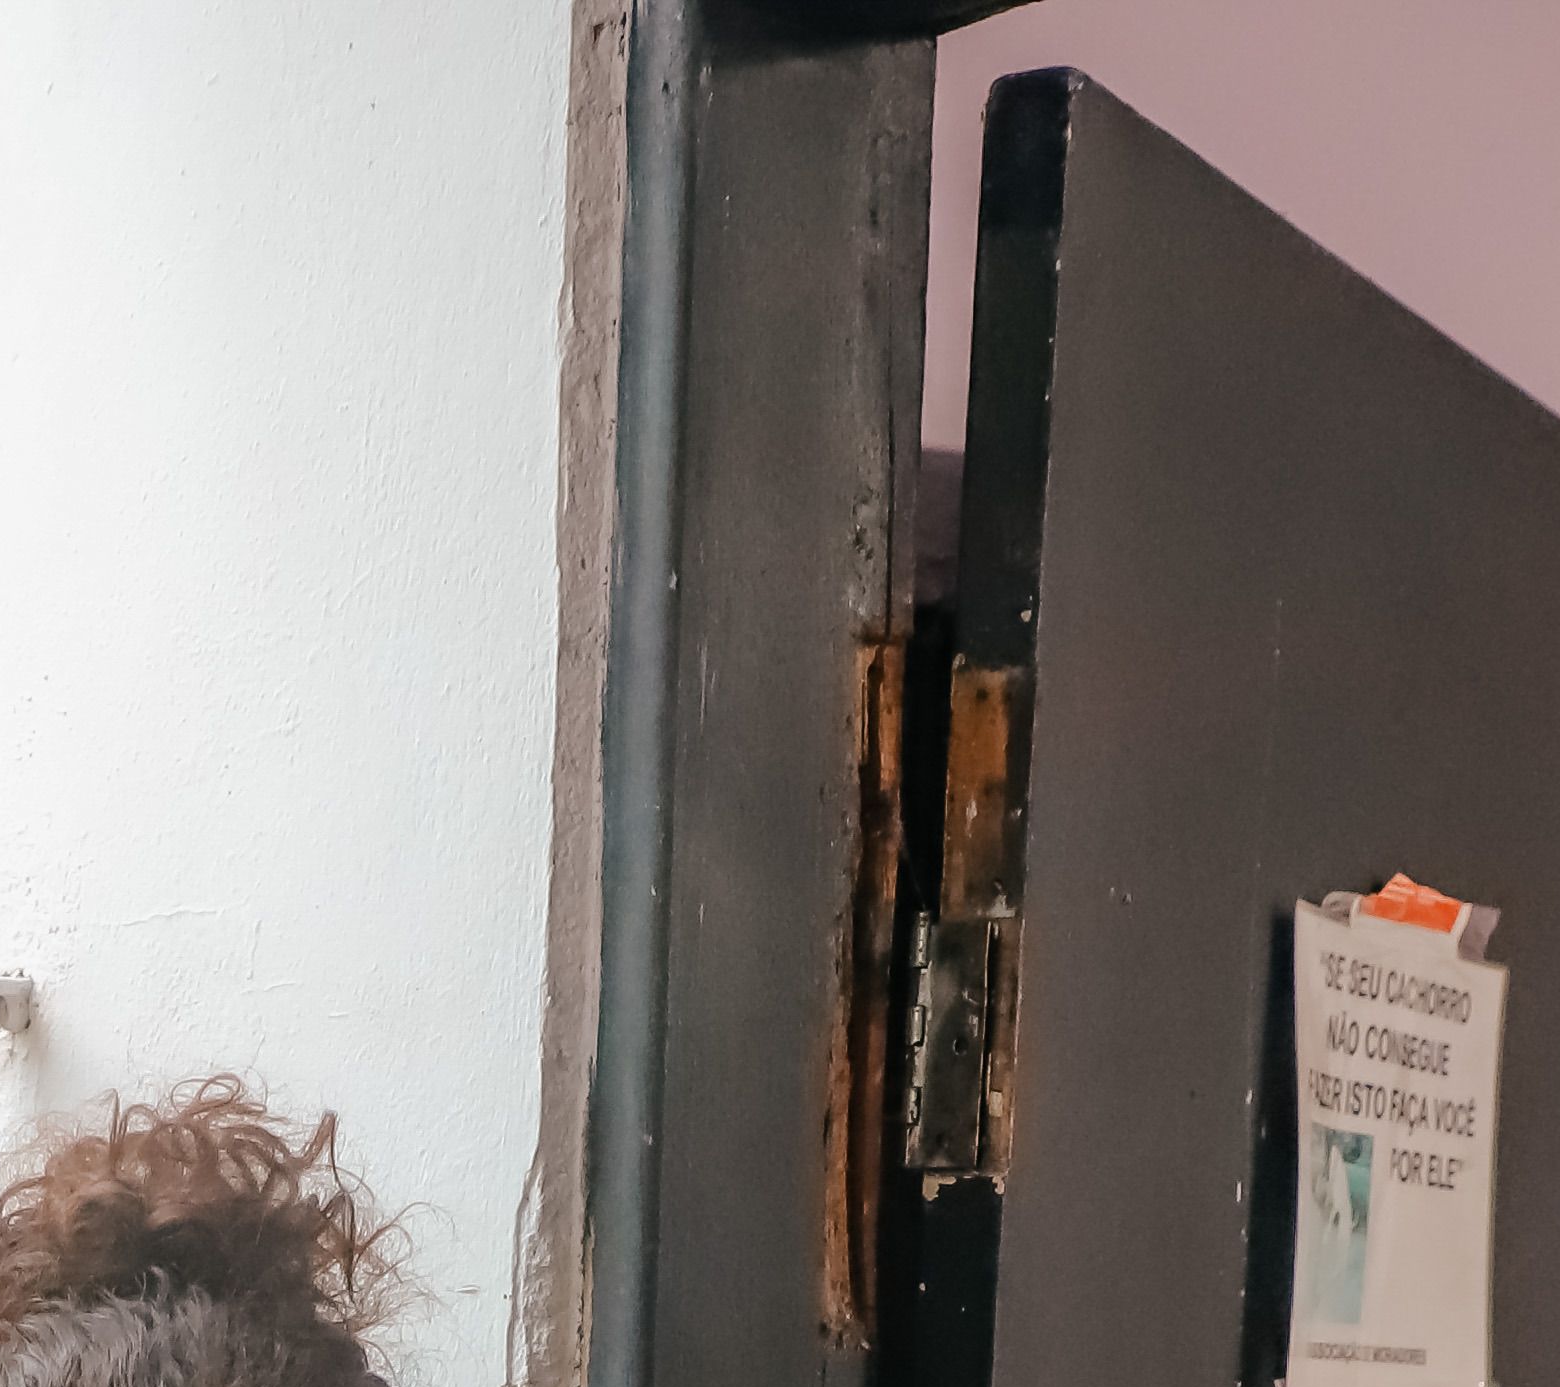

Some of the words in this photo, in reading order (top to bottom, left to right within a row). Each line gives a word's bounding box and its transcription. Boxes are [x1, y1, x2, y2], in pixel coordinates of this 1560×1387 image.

[1349, 959, 1382, 1000] SEU
[1386, 969, 1473, 1025] CACHORRO
[1326, 1011, 1360, 1057] NÃO
[1365, 1024, 1451, 1077] CONSEGUE
[1344, 1081, 1388, 1120] ISTO
[1389, 1088, 1431, 1137] FAÇA
[1433, 1096, 1477, 1138] VOCÊ
[1390, 1148, 1424, 1186] POR
